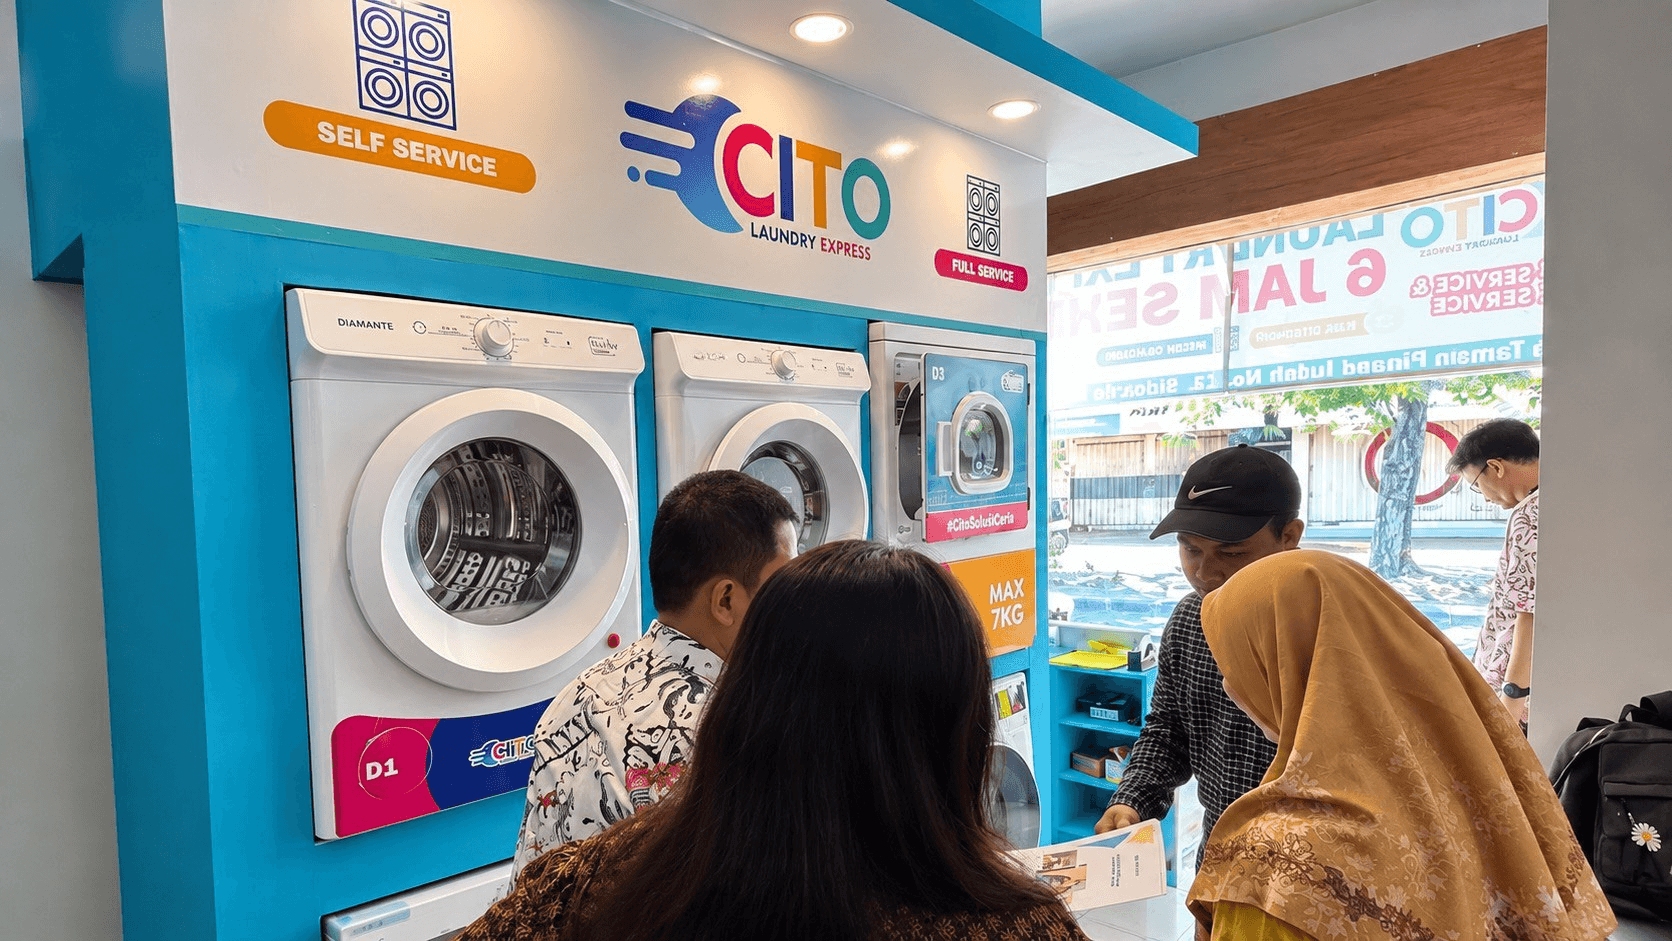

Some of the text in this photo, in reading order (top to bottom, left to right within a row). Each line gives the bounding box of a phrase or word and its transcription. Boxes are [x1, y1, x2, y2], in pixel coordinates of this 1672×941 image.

[316, 120, 498, 178] SELF SERVICE
[722, 123, 891, 240] CITO
[750, 222, 872, 261] LAUNDRY EXPRESS
[951, 259, 1014, 284] FULL SERVICE
[337, 317, 394, 331] DIAMANTE
[932, 366, 945, 381] D3
[989, 578, 1025, 605] MAX
[991, 603, 1025, 631] 7KG
[365, 758, 399, 781] D1
